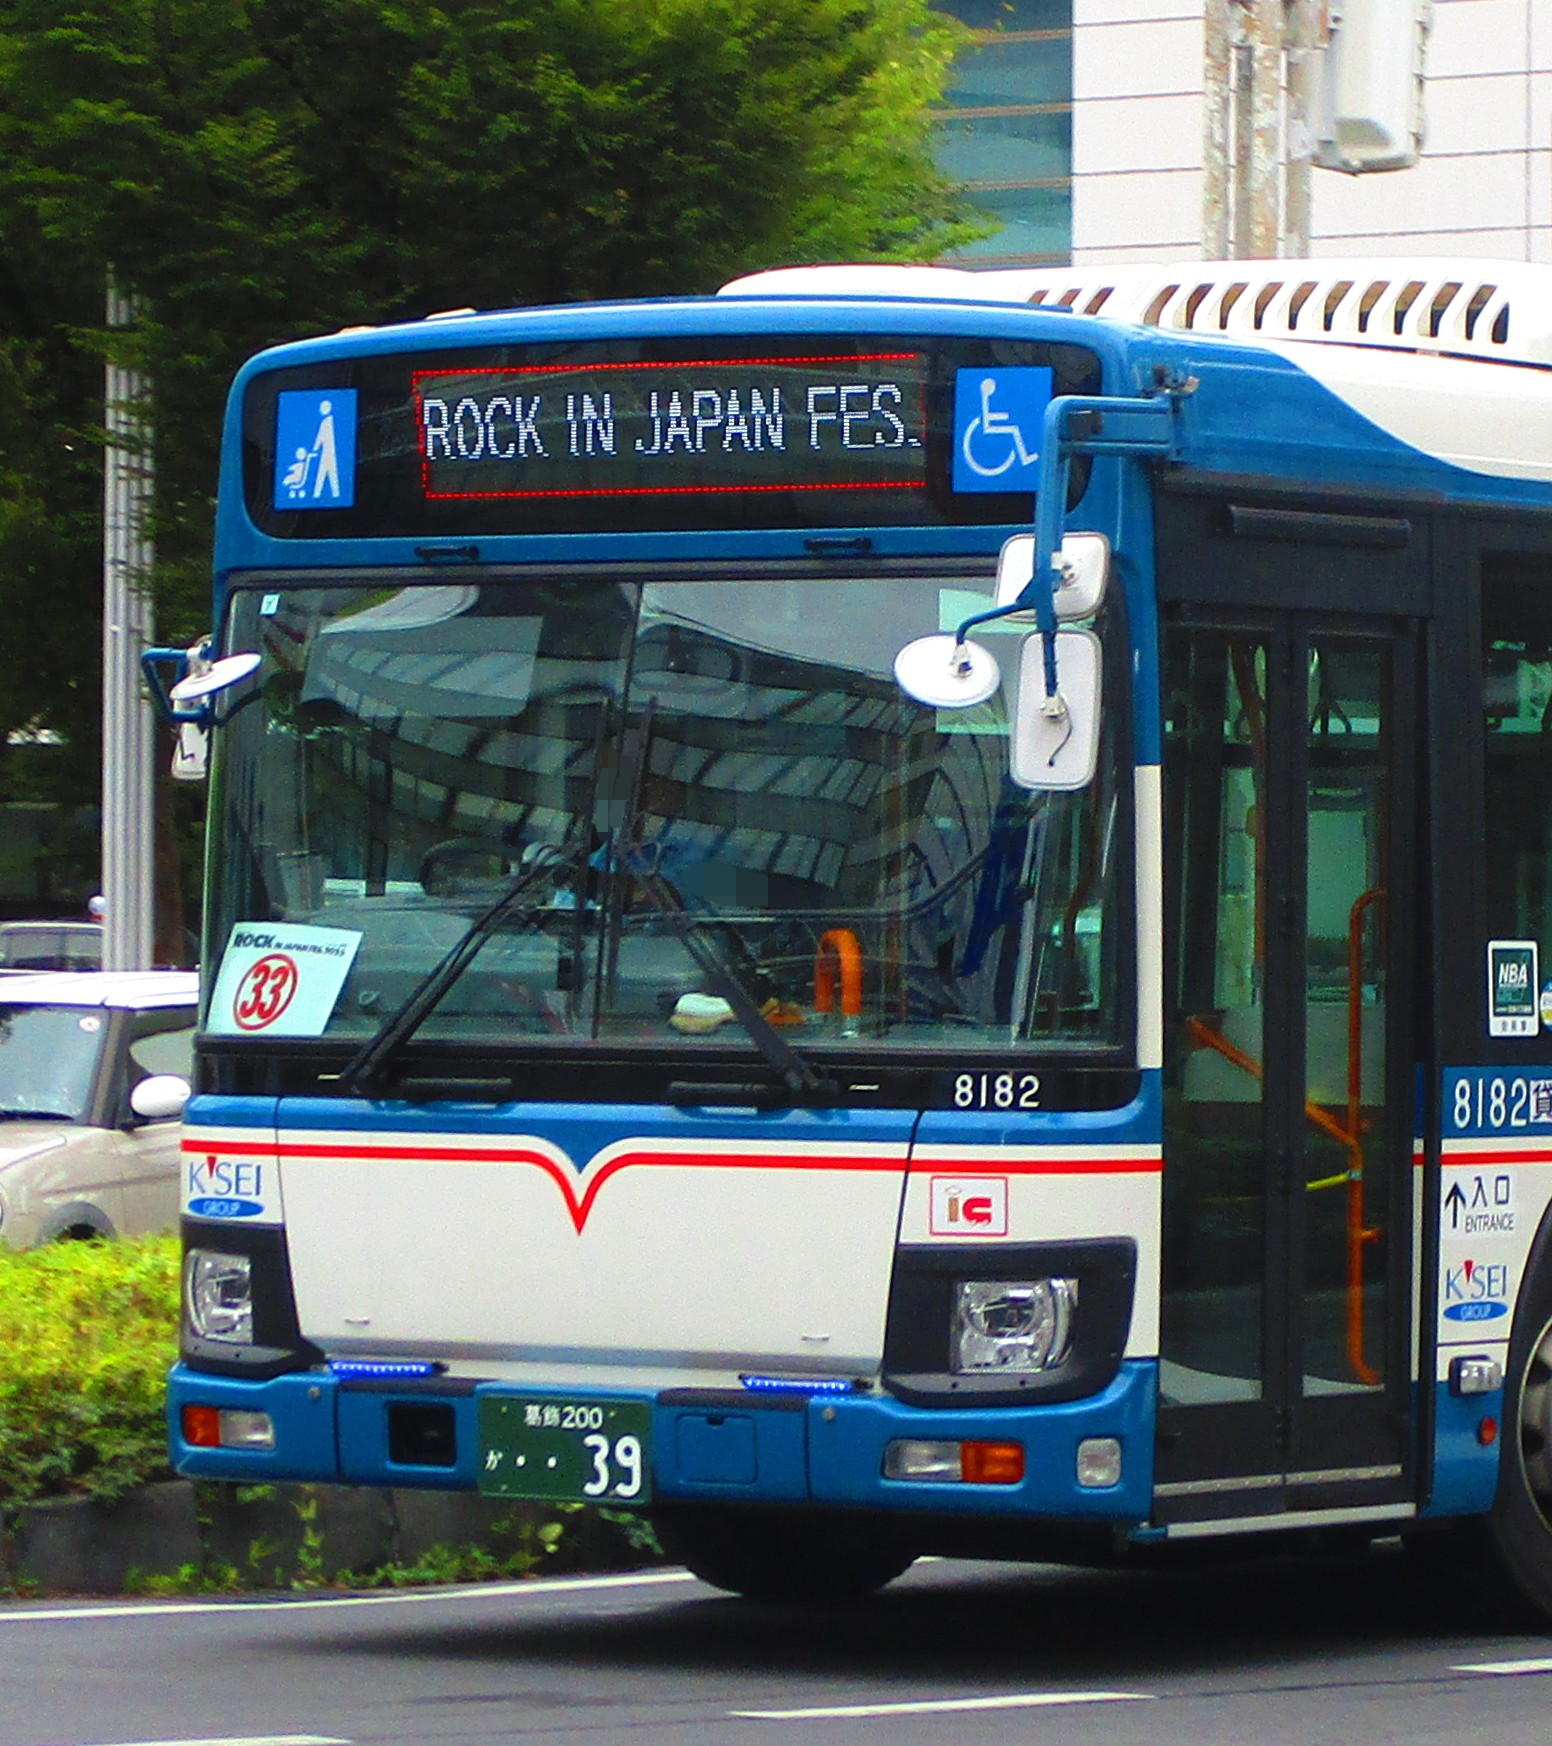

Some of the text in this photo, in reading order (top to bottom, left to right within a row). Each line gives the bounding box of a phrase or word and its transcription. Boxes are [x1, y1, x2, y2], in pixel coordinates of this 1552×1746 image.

[424, 383, 920, 460] ROCK IN JAPAN FES.
[234, 933, 275, 949] ROCK
[1499, 963, 1528, 984] NBA
[240, 964, 292, 1019] 33
[955, 1074, 1040, 1108] 8182
[1454, 1077, 1527, 1128] 8182
[1471, 1176, 1509, 1208] 入口
[203, 1199, 241, 1217] GROUP
[1465, 1212, 1515, 1233] ENTRANCE
[1460, 1303, 1491, 1320] GROUP
